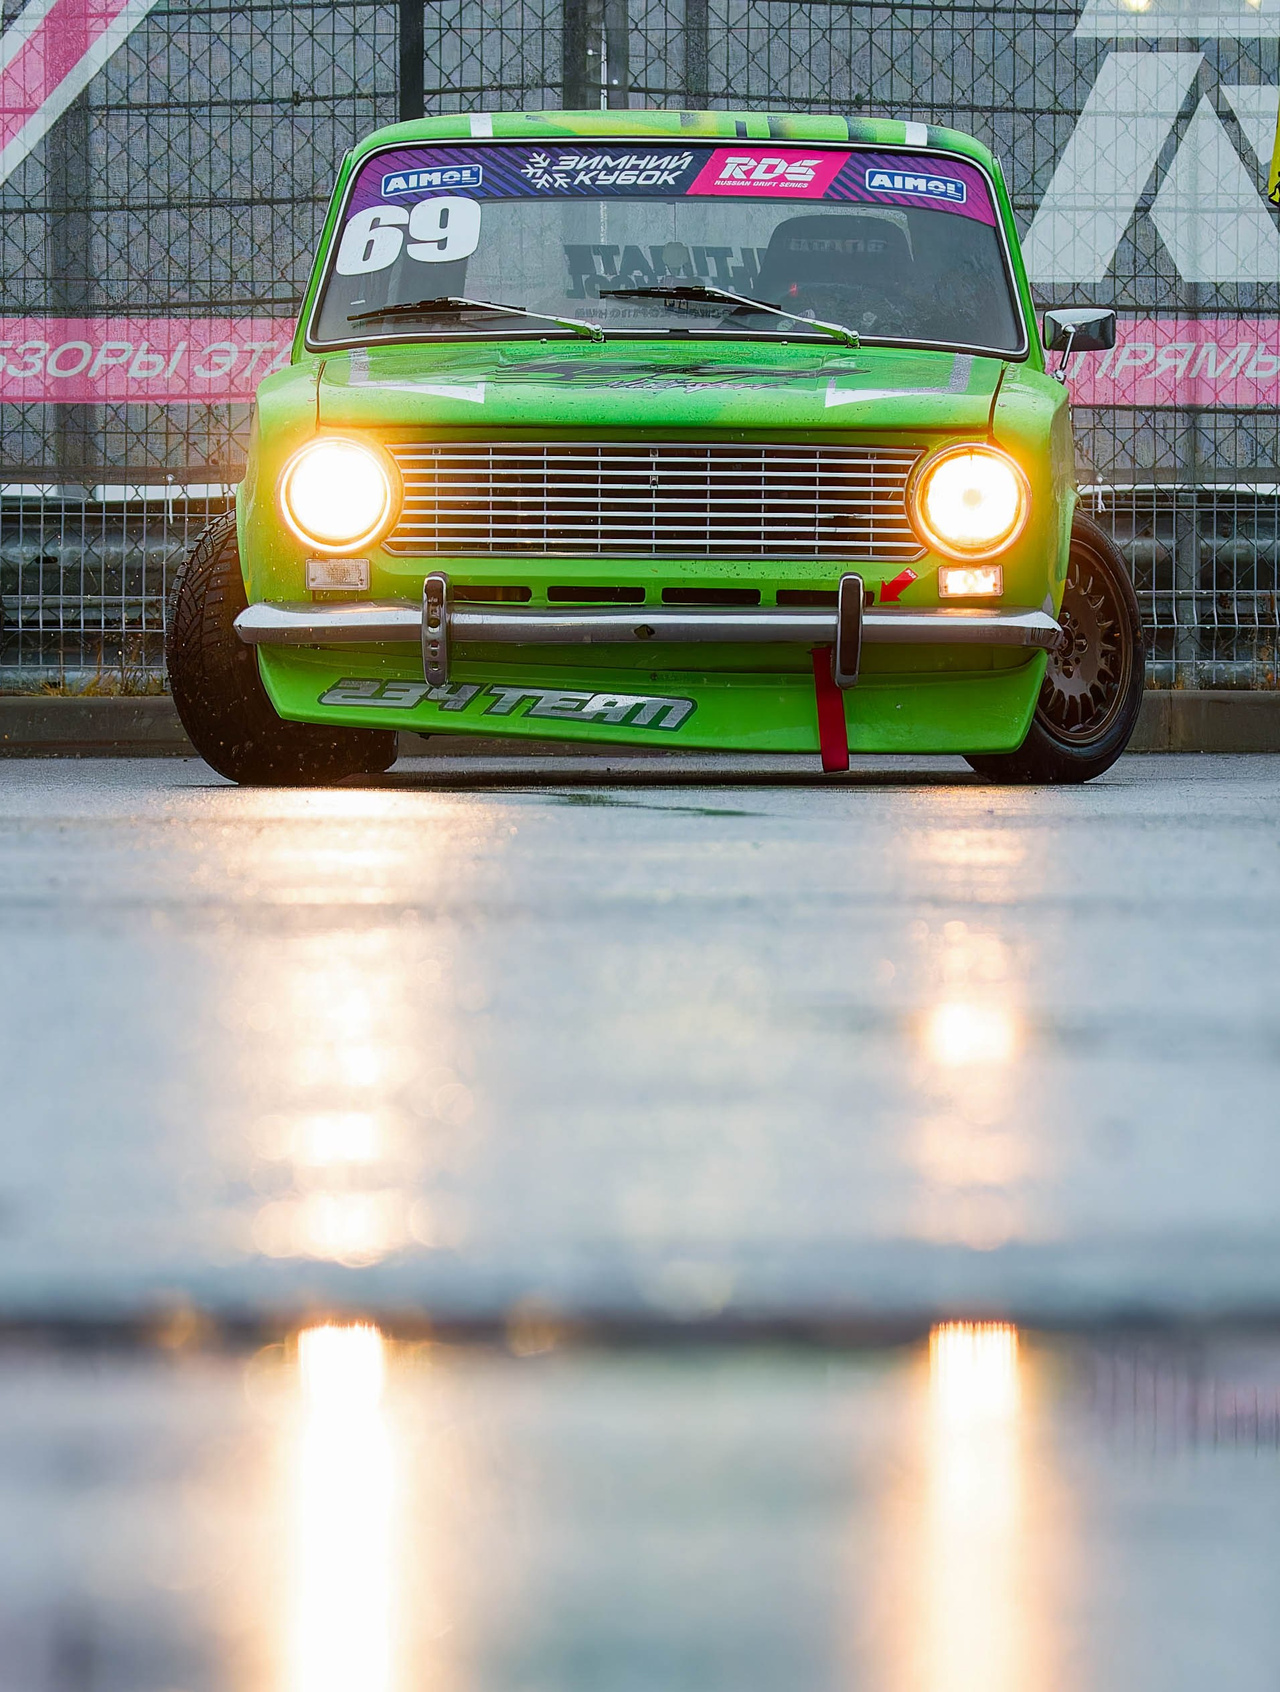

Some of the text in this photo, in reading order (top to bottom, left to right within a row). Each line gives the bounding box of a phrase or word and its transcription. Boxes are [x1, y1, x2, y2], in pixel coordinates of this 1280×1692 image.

[552, 151, 694, 171] ЗИМНИЙ
[718, 156, 824, 182] RDS
[385, 168, 478, 193] AIMOL
[572, 170, 681, 186] КУБОК
[714, 179, 752, 187] RUSSIAN
[752, 180, 777, 188] DRIFT
[869, 173, 963, 199] AIMOL
[335, 197, 482, 276] 69
[320, 679, 696, 730] 234 TEAM
